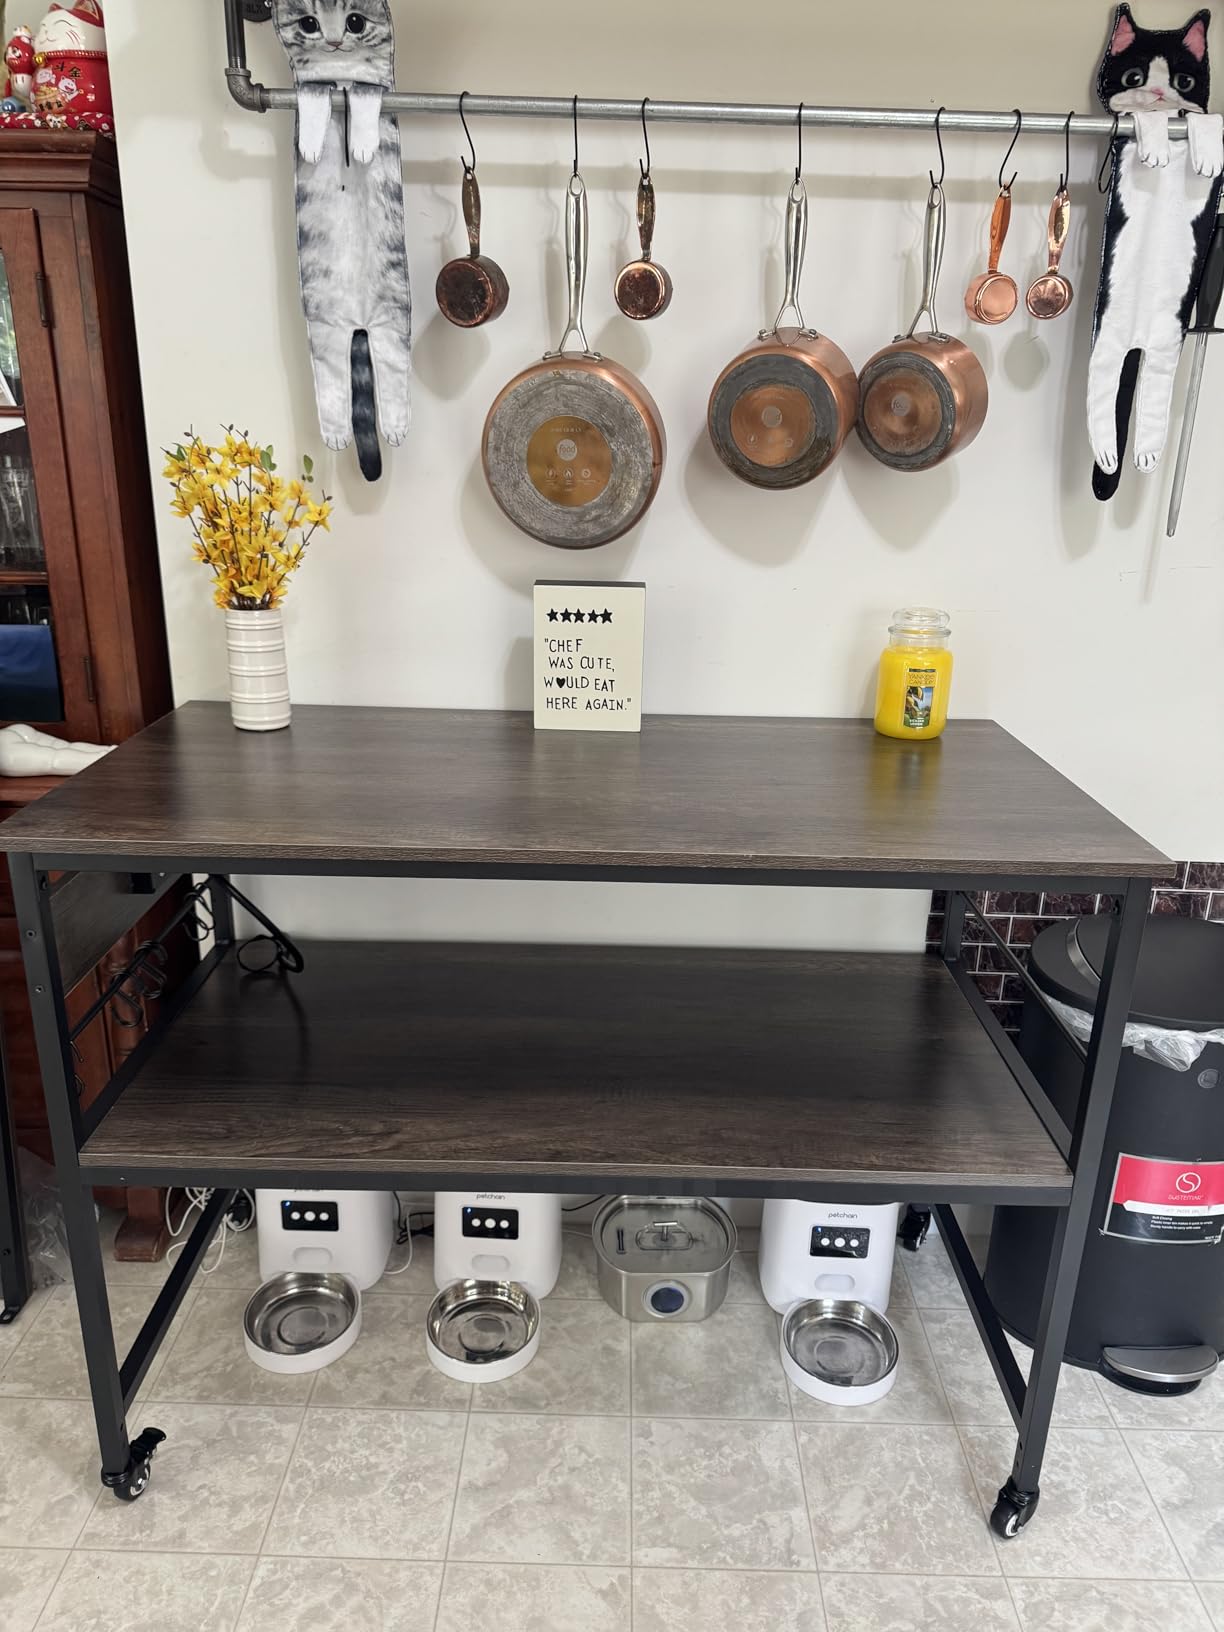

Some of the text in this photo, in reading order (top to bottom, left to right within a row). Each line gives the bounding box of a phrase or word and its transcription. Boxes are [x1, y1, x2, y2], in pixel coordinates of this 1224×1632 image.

[544, 637, 583, 653] "CHEF
[548, 655, 615, 672] WAS CUTE,
[594, 678, 615, 693] EAT
[546, 696, 632, 711] HERE AGAIN."
